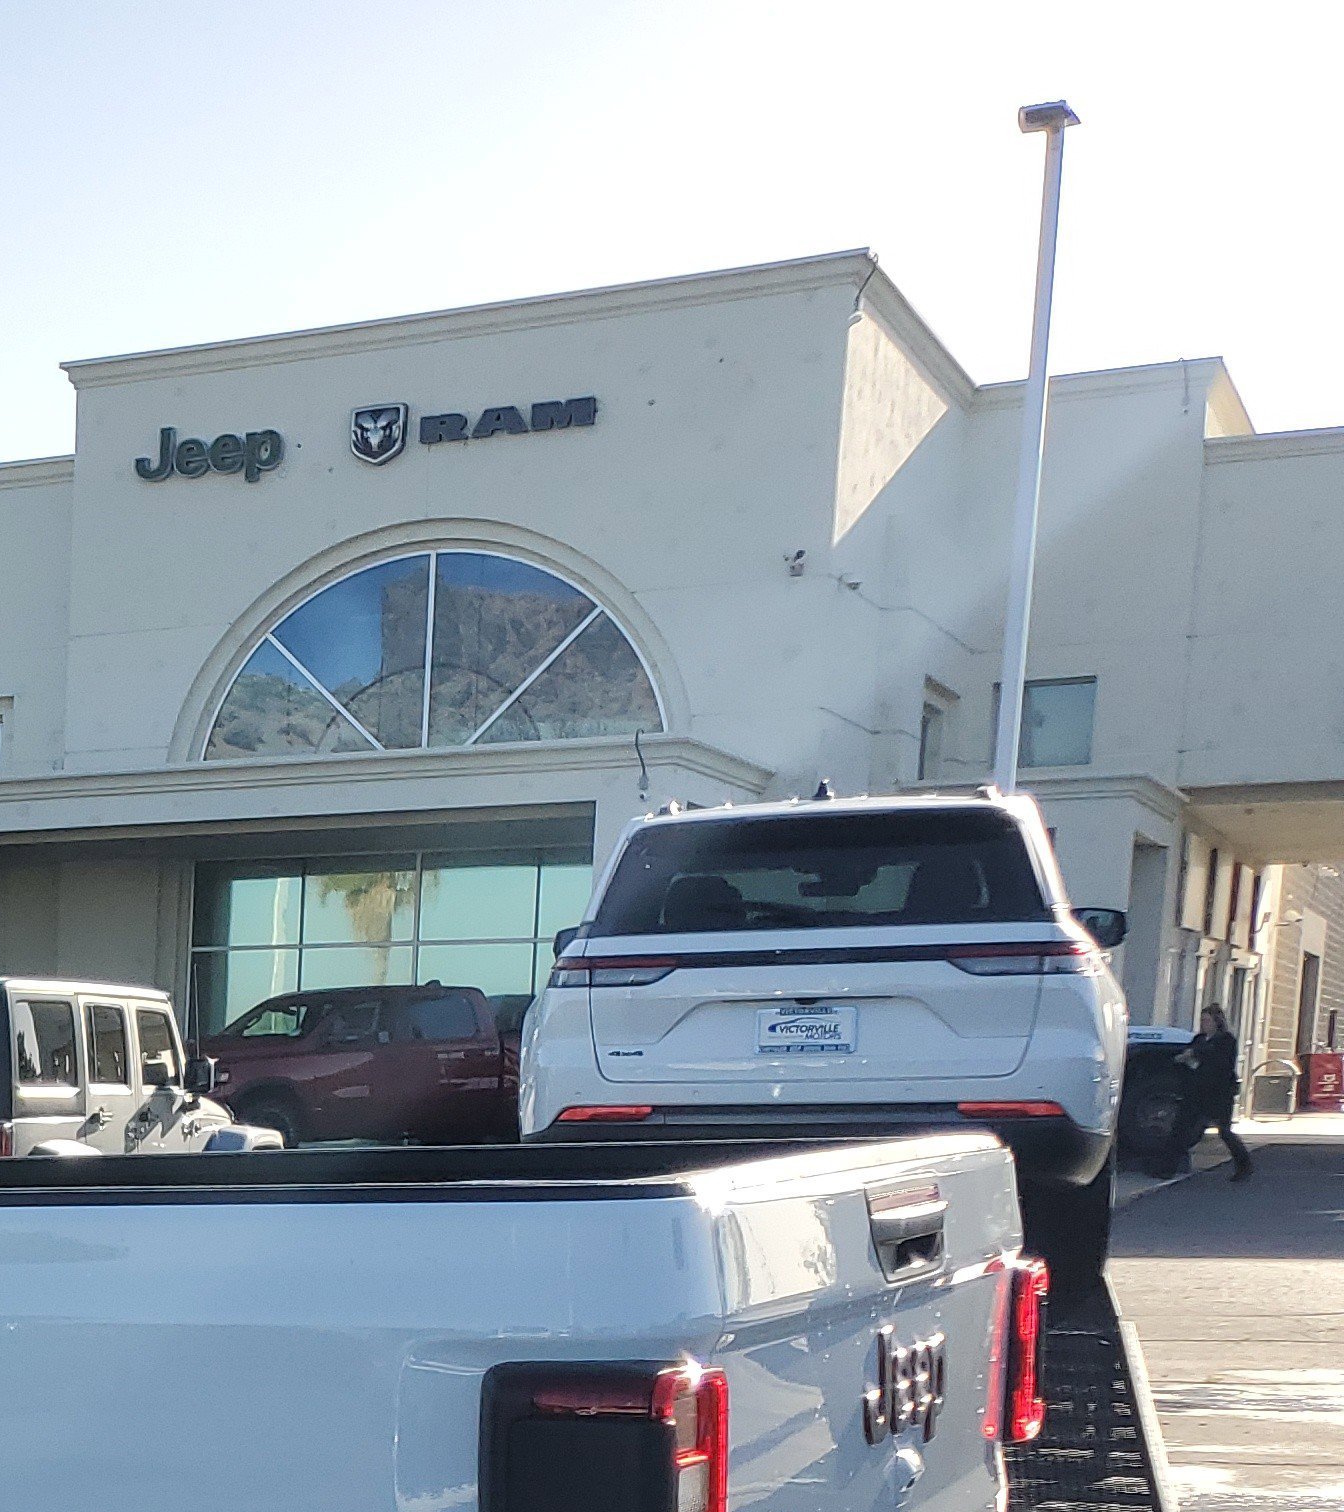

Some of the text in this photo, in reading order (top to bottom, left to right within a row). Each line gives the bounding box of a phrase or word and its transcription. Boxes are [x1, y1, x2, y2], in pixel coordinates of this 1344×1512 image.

[420, 396, 598, 444] RAM
[134, 426, 286, 483] Jeep
[779, 1023, 841, 1033] VICTORVILLE
[862, 1324, 946, 1446] Jeep
